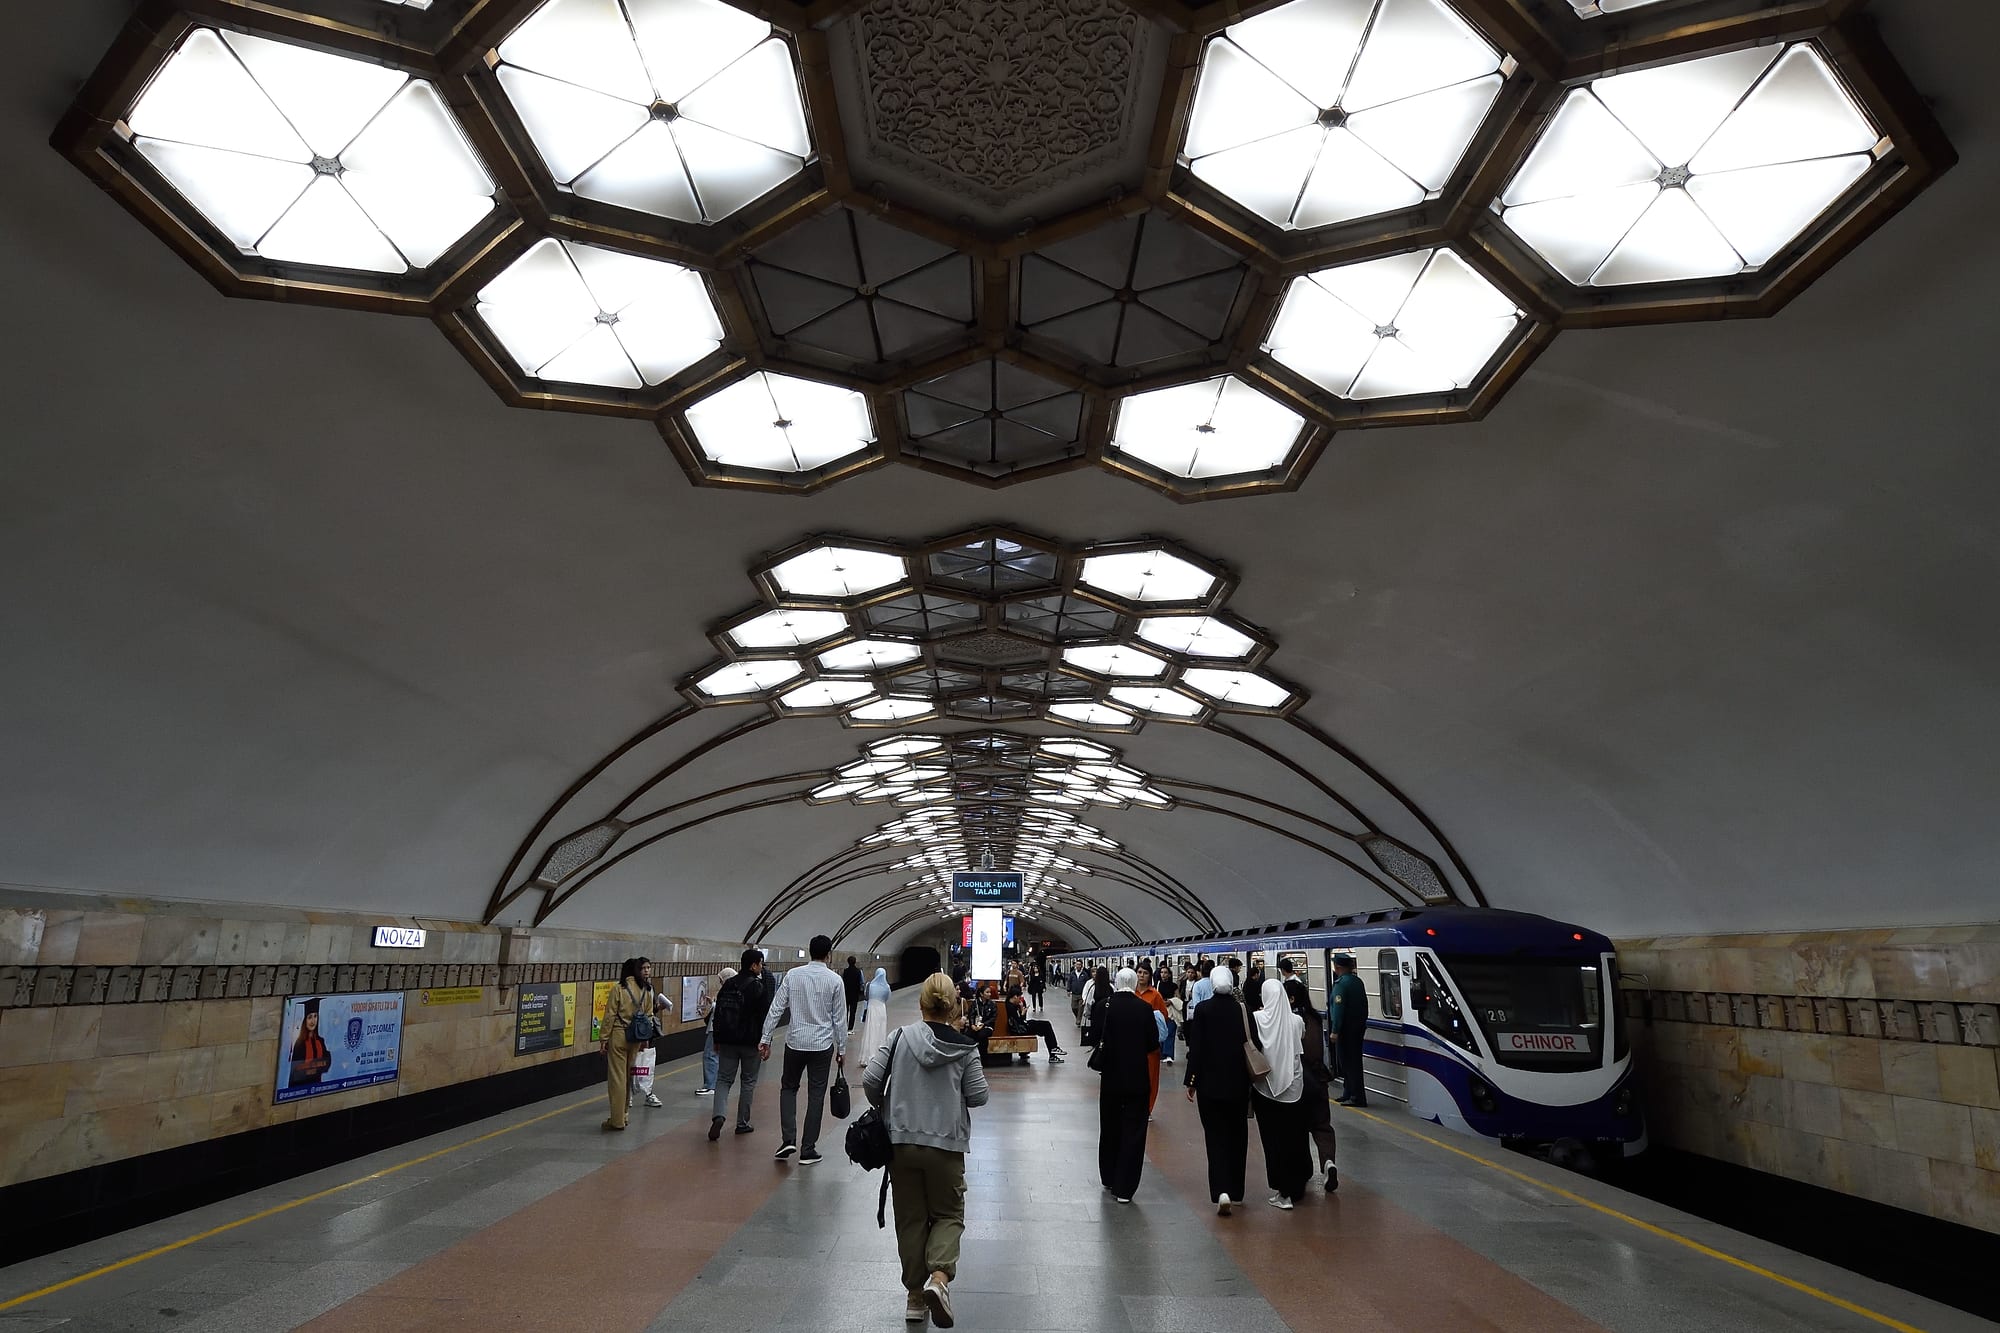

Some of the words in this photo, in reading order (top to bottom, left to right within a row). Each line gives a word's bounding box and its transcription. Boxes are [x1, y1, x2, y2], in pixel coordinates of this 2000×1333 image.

[380, 929, 421, 946] NOVZA
[522, 992, 534, 1002] AVO
[367, 1023, 395, 1035] DIPLOMAT
[1511, 1034, 1576, 1050] CHINOR
